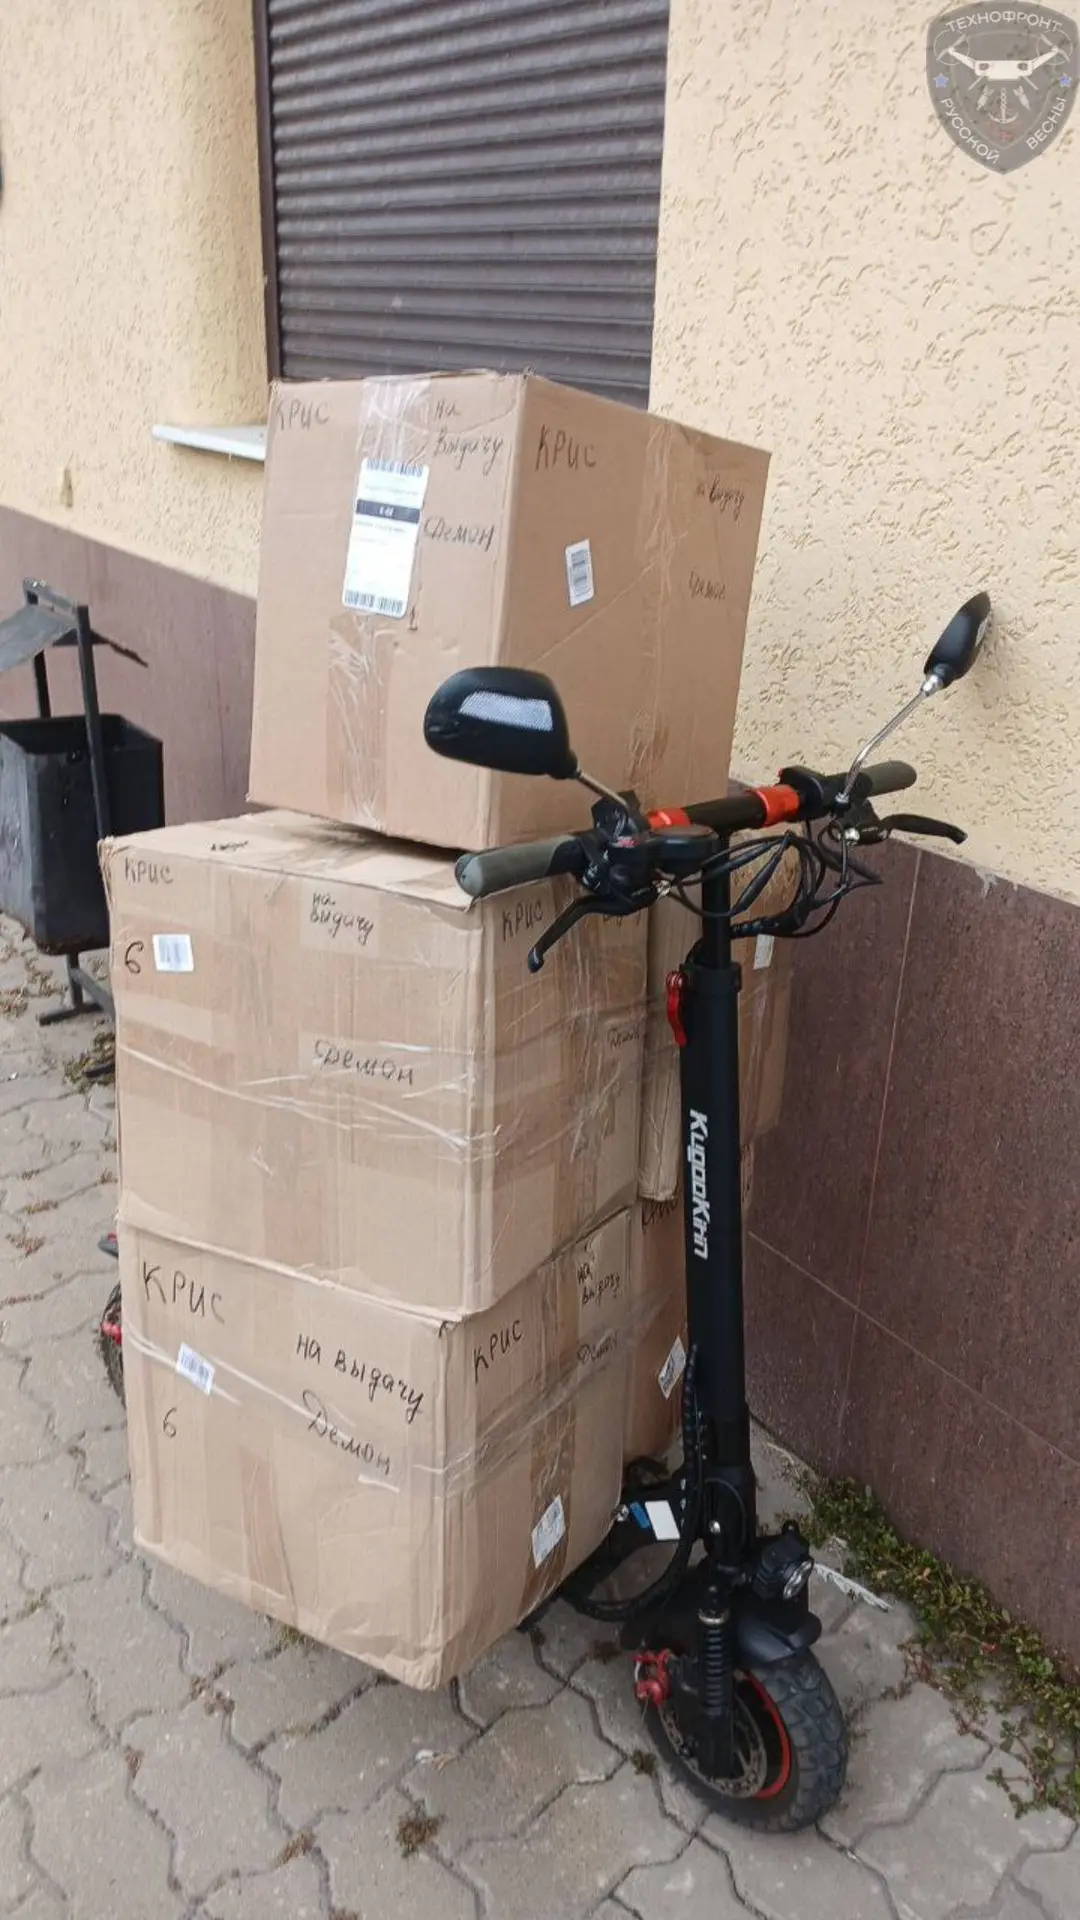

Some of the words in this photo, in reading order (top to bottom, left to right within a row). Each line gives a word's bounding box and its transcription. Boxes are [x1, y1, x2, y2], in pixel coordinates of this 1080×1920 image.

[275, 399, 330, 431] КРИС
[535, 424, 599, 472] КРИС
[124, 857, 174, 884] КРИС
[124, 940, 145, 974] 6
[143, 1261, 225, 1325] КРИС
[472, 1320, 525, 1383] КРИС
